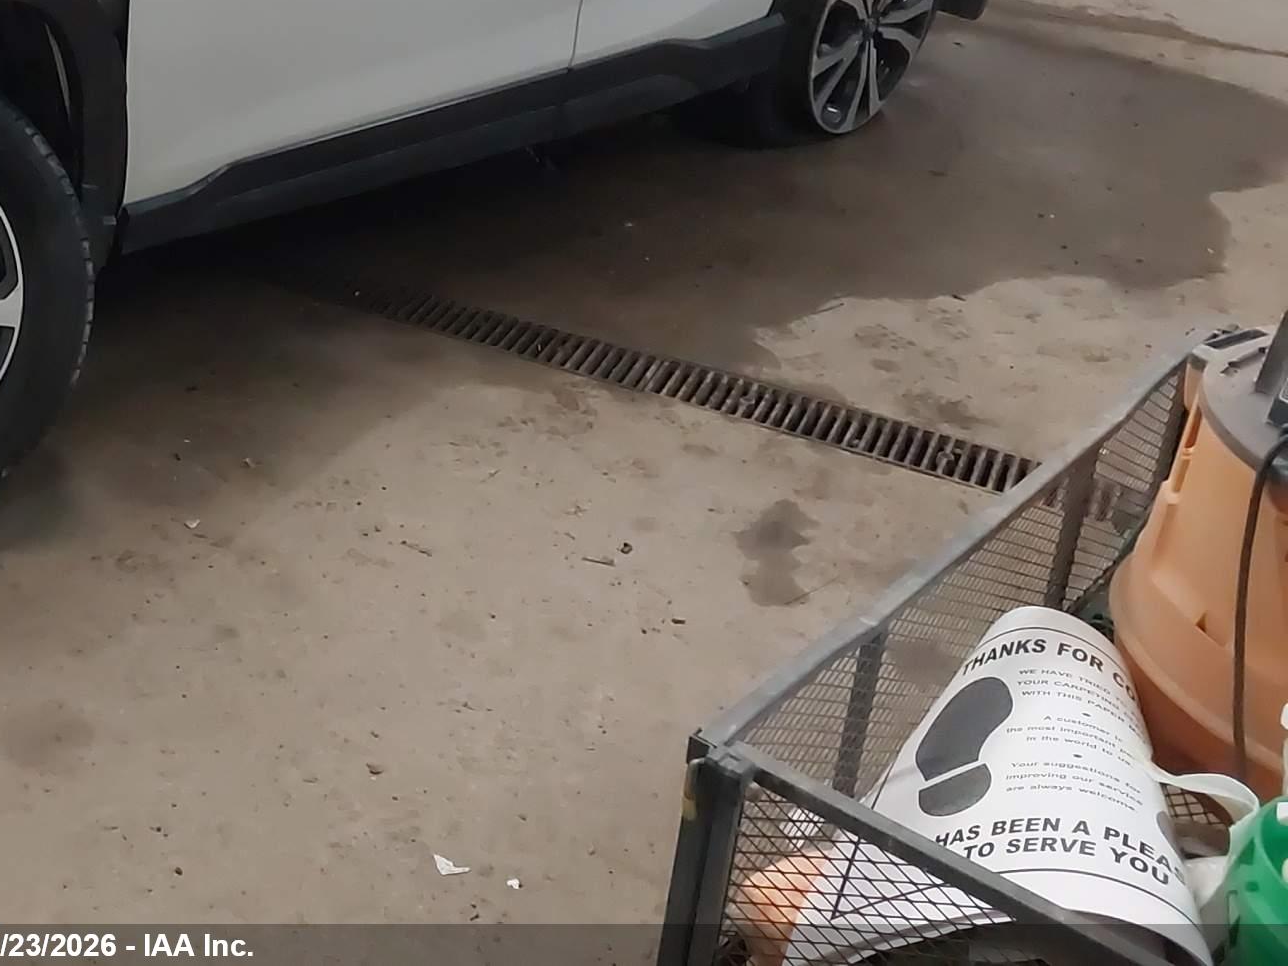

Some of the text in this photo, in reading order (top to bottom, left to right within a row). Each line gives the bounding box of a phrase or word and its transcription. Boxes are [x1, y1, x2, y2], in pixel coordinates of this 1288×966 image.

[963, 638, 1047, 676] THANKS
[1057, 642, 1104, 672] FOR
[1041, 668, 1073, 678] HAVE
[1057, 691, 1082, 702] THIS
[1087, 699, 1125, 722] PAPER
[1057, 717, 1110, 735] customer
[1060, 726, 1116, 748] important
[1064, 737, 1097, 749] world
[1102, 748, 1113, 756] to
[1043, 762, 1120, 783] suggestions
[1125, 782, 1141, 793] for
[1072, 775, 1094, 783] our
[1099, 782, 1143, 806] service
[935, 825, 980, 846] HAS
[991, 817, 1061, 836] BEEN
[1072, 820, 1090, 835] A
[963, 837, 1170, 885] TO SERVE YOU
